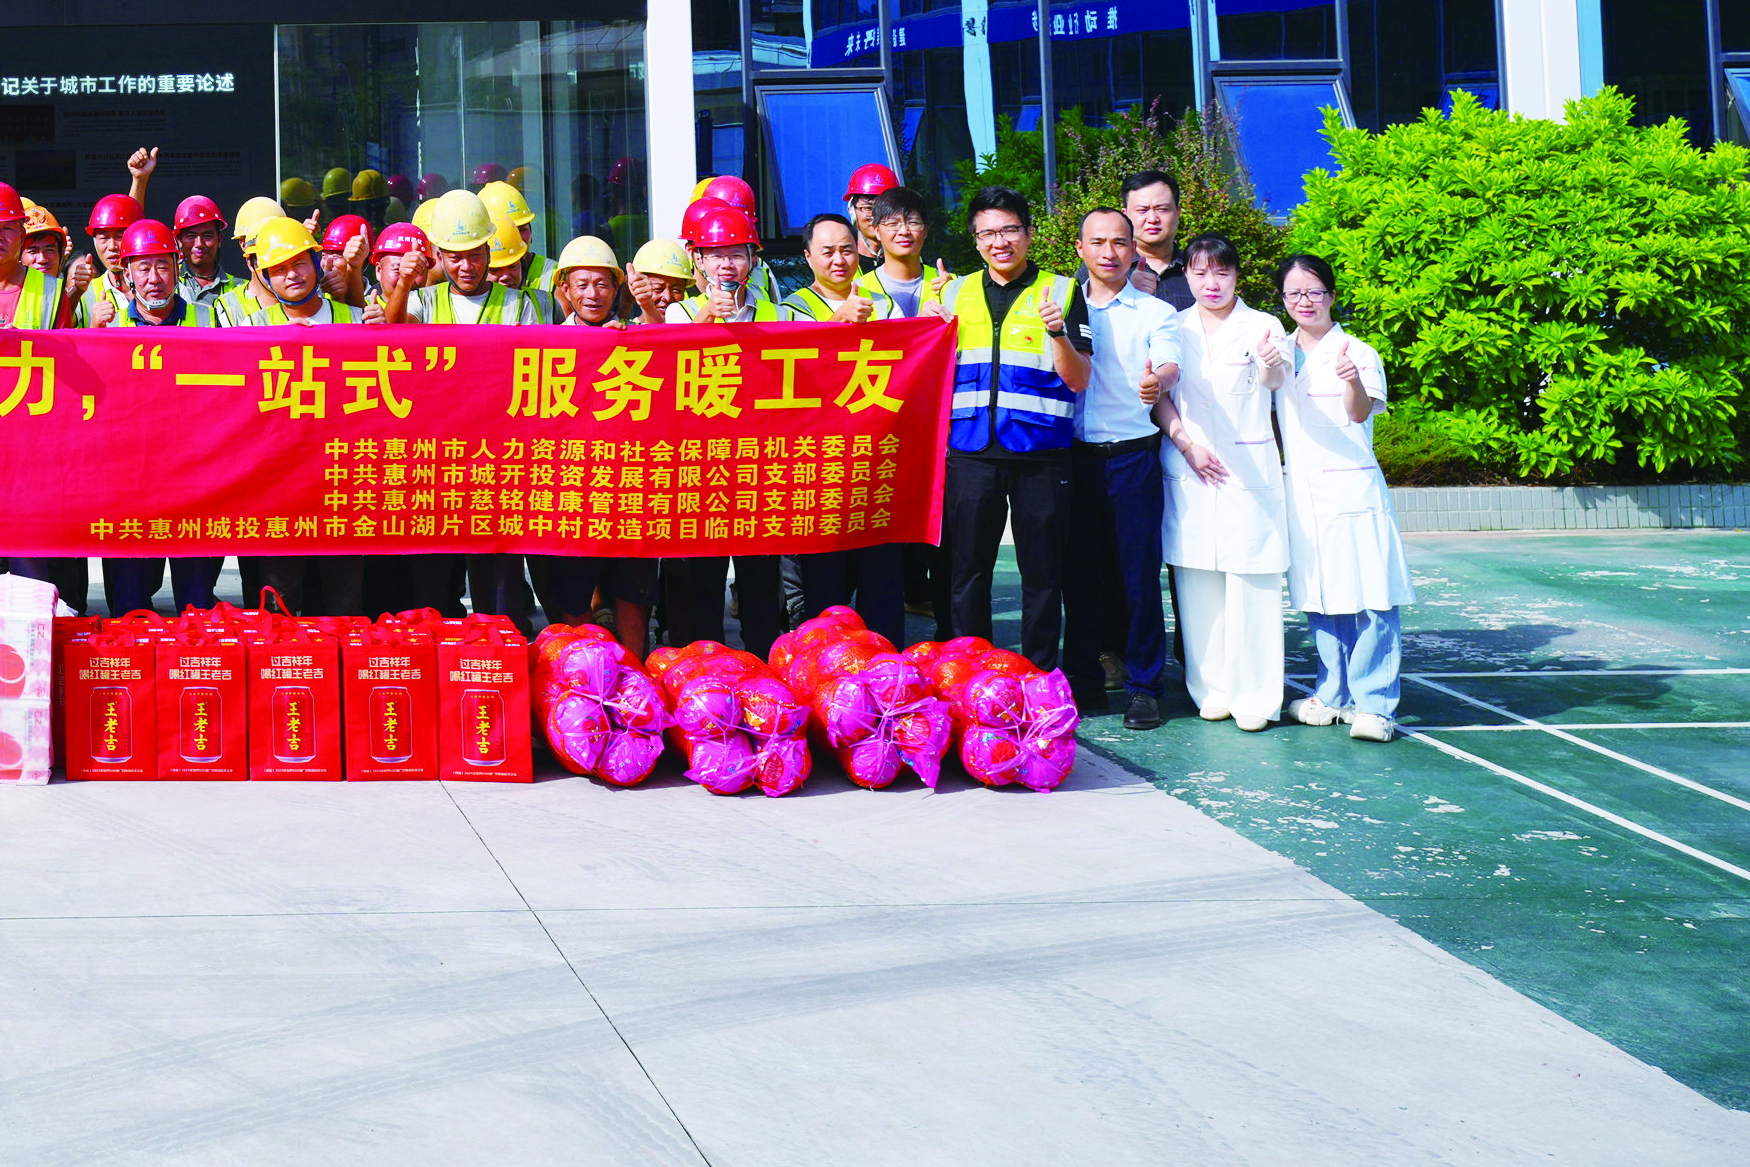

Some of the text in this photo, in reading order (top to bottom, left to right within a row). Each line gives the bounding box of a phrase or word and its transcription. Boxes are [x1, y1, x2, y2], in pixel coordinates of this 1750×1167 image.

[324, 434, 901, 460] 中共惠州市人力资源和社会保障局机关委员会
[324, 461, 899, 488] 中共惠州市城开投资发展有限公司支部委员会
[324, 486, 894, 513] 中共惠州市慈铭健康管理有限公司支部委员会
[90, 508, 891, 541] 中共惠州城投惠州市金山湖片区城中村改造项目临时支部委员会
[89, 657, 130, 668] 过吉祥年
[179, 657, 221, 668] 过吉祥年
[271, 656, 313, 667] 过吉祥年
[368, 657, 411, 668] 过吉祥年
[460, 659, 502, 670] 过吉祥年
[104, 702, 118, 751] 王老吉
[194, 702, 208, 751] 王老吉
[286, 702, 301, 751] 王老吉
[383, 702, 397, 751] 王老吉
[476, 705, 490, 754] 王老吉
